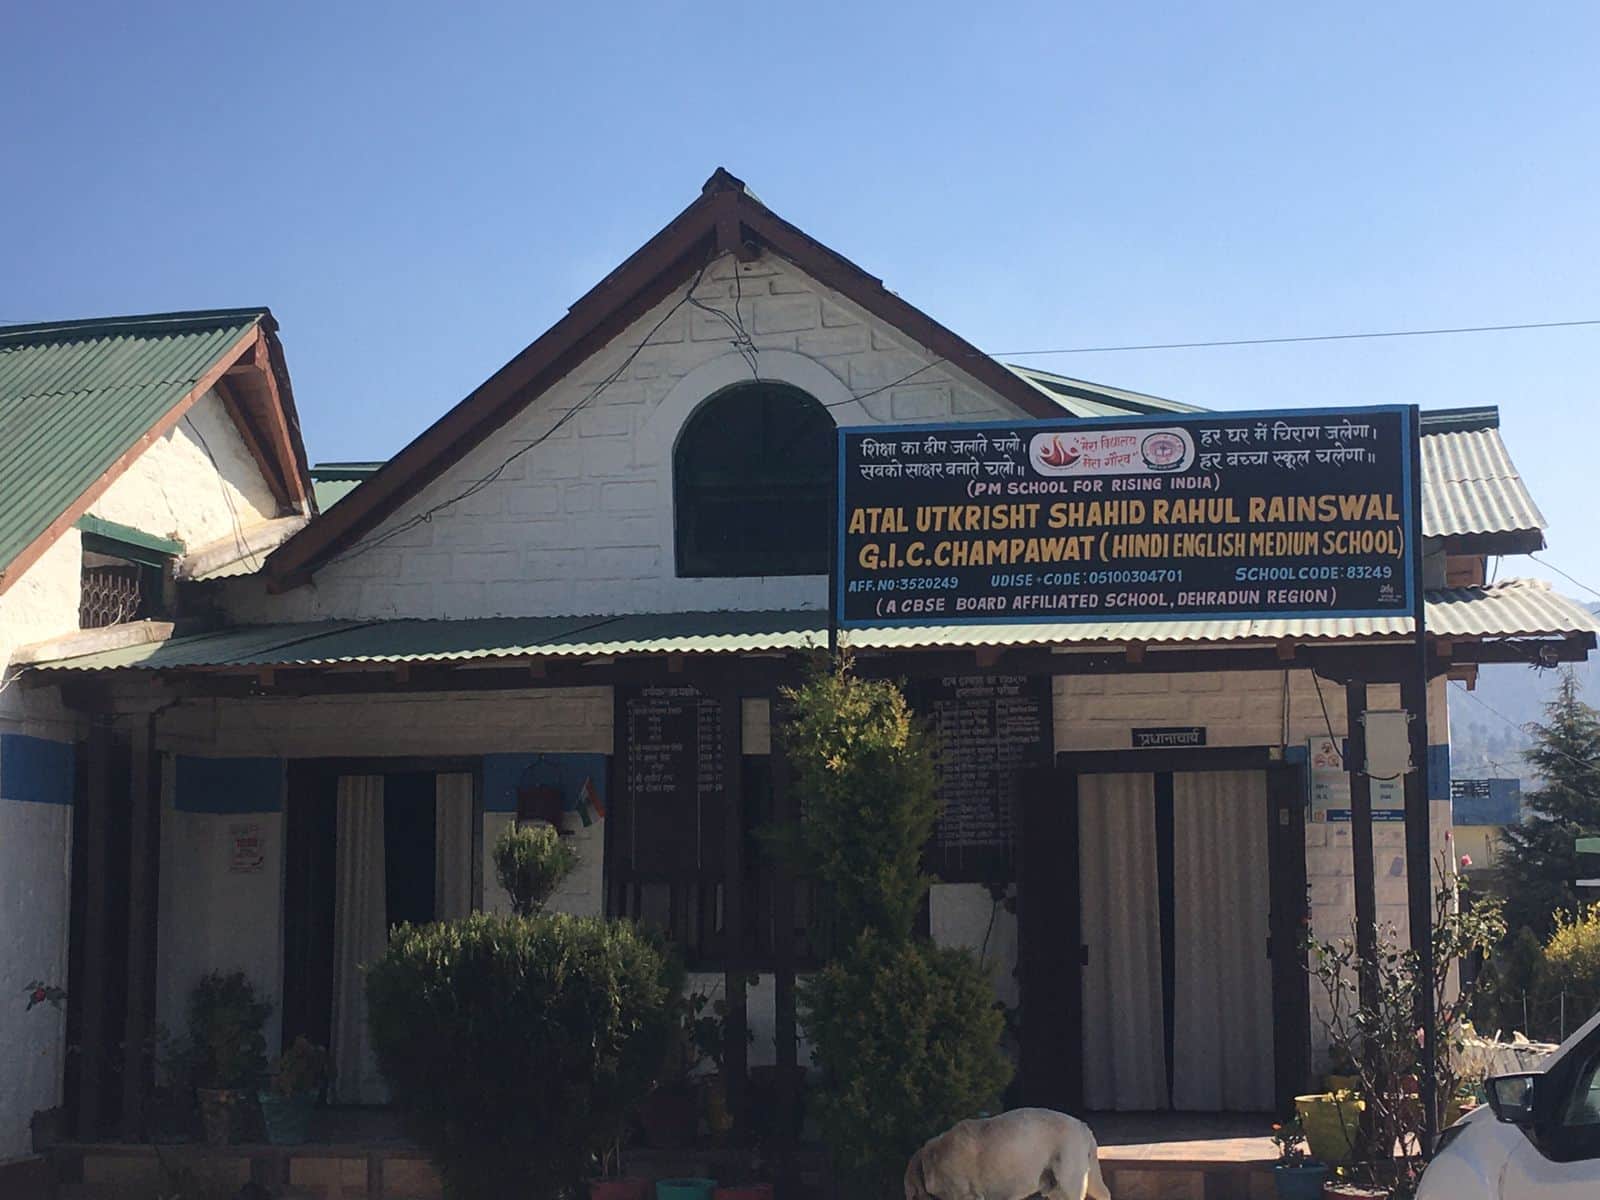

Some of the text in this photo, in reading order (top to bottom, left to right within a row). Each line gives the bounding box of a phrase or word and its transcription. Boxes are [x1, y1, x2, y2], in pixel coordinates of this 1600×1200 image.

[859, 437, 897, 459] शिक्षा
[901, 441, 920, 455] का
[923, 436, 947, 456] दीप
[950, 432, 988, 456] जलाते
[1199, 429, 1222, 448] हर
[1224, 428, 1251, 445] घर
[1253, 422, 1268, 441] में
[1271, 420, 1321, 442] चिराग
[905, 463, 944, 479] साक्षर
[1199, 453, 1223, 471] हर
[1226, 451, 1269, 466] बच्चा
[1272, 450, 1311, 470] स्कूल
[967, 473, 1220, 498] (PM SCHOOL FOR RISING INDIA)
[848, 493, 1400, 534] ATAL UTKRISHT SHAHID RAHUL RAINSWAL
[1100, 531, 1169, 562] (HINDI
[1172, 532, 1246, 558] ENGLISH
[1250, 530, 1319, 557] MEDIUM
[1322, 525, 1404, 560] SCHOOL)
[1234, 566, 1296, 582] SCHOOL
[901, 597, 946, 612] CBSE
[956, 596, 1007, 611] BOARD
[1012, 594, 1099, 610] AFFILIATED
[1177, 590, 1263, 607] DEHRADUN
[1267, 586, 1337, 608] REGION)
[1136, 728, 1201, 747] प्रधानाचार्य
